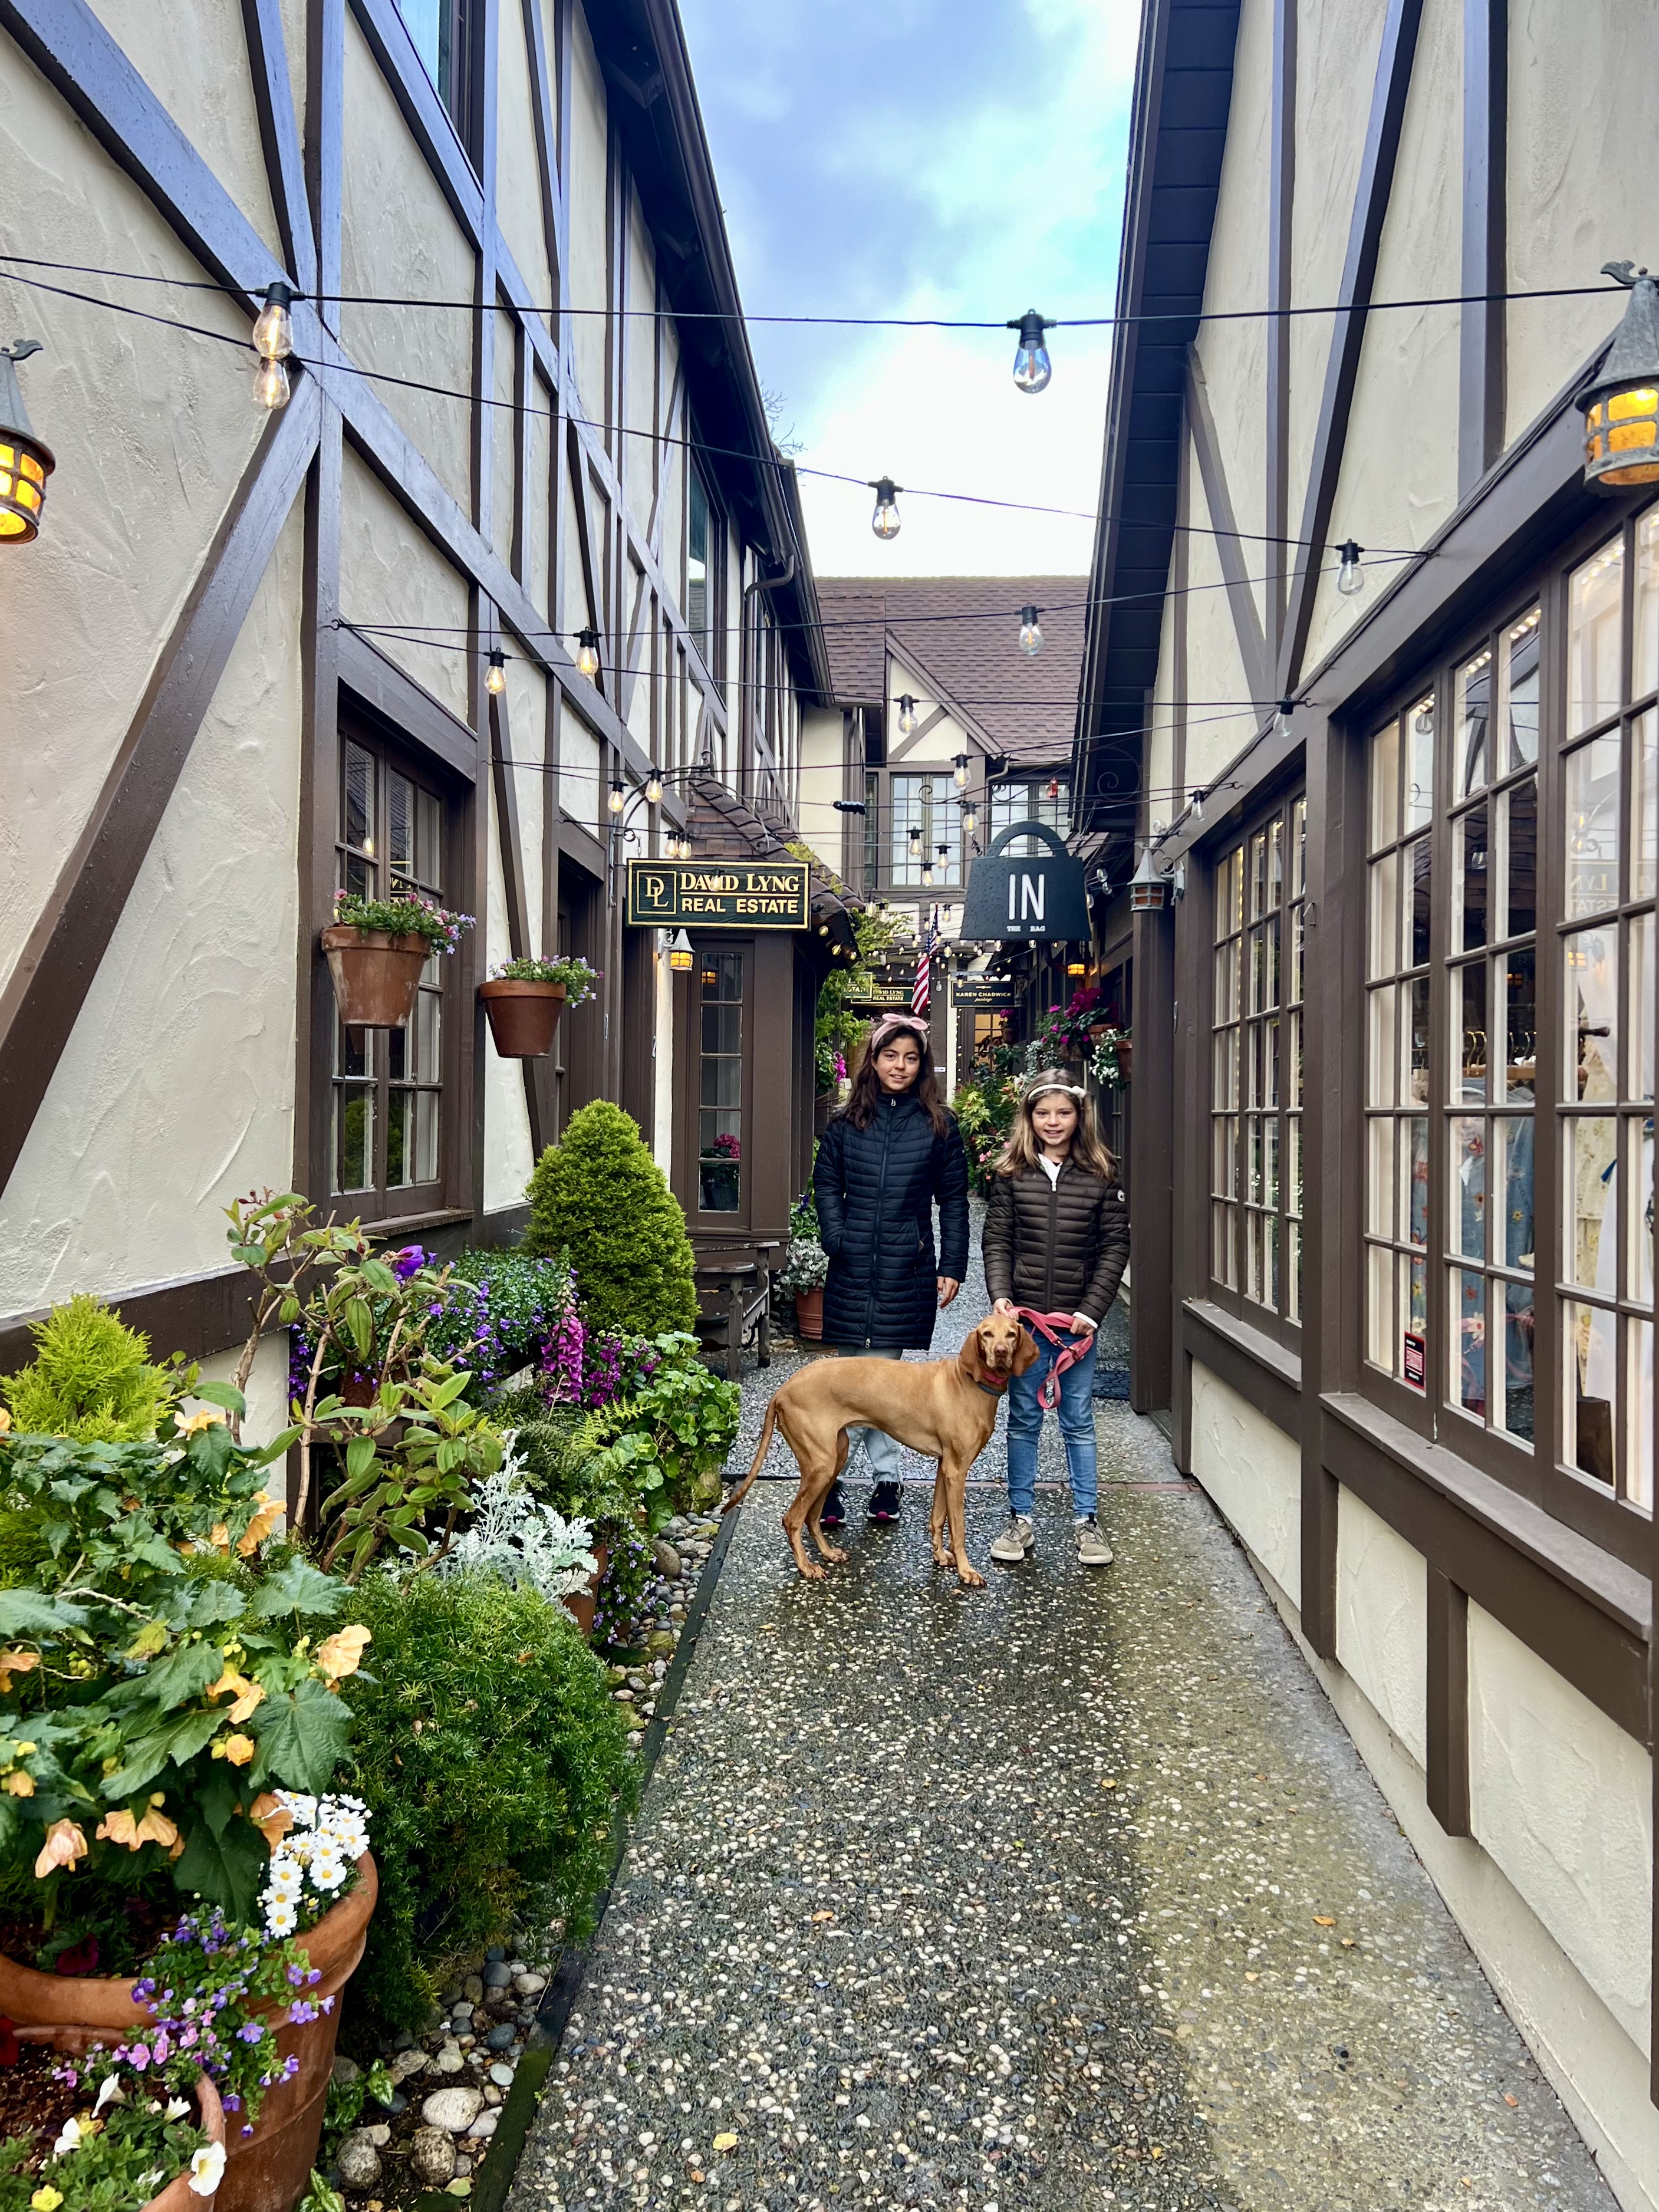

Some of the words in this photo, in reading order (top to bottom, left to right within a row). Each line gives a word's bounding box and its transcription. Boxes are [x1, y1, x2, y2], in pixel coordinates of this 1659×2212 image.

[680, 873, 739, 892] DAVID
[746, 873, 799, 892] LYNG
[682, 898, 726, 913] REAL
[736, 898, 798, 914] ESTATE
[1009, 874, 1045, 920] IN
